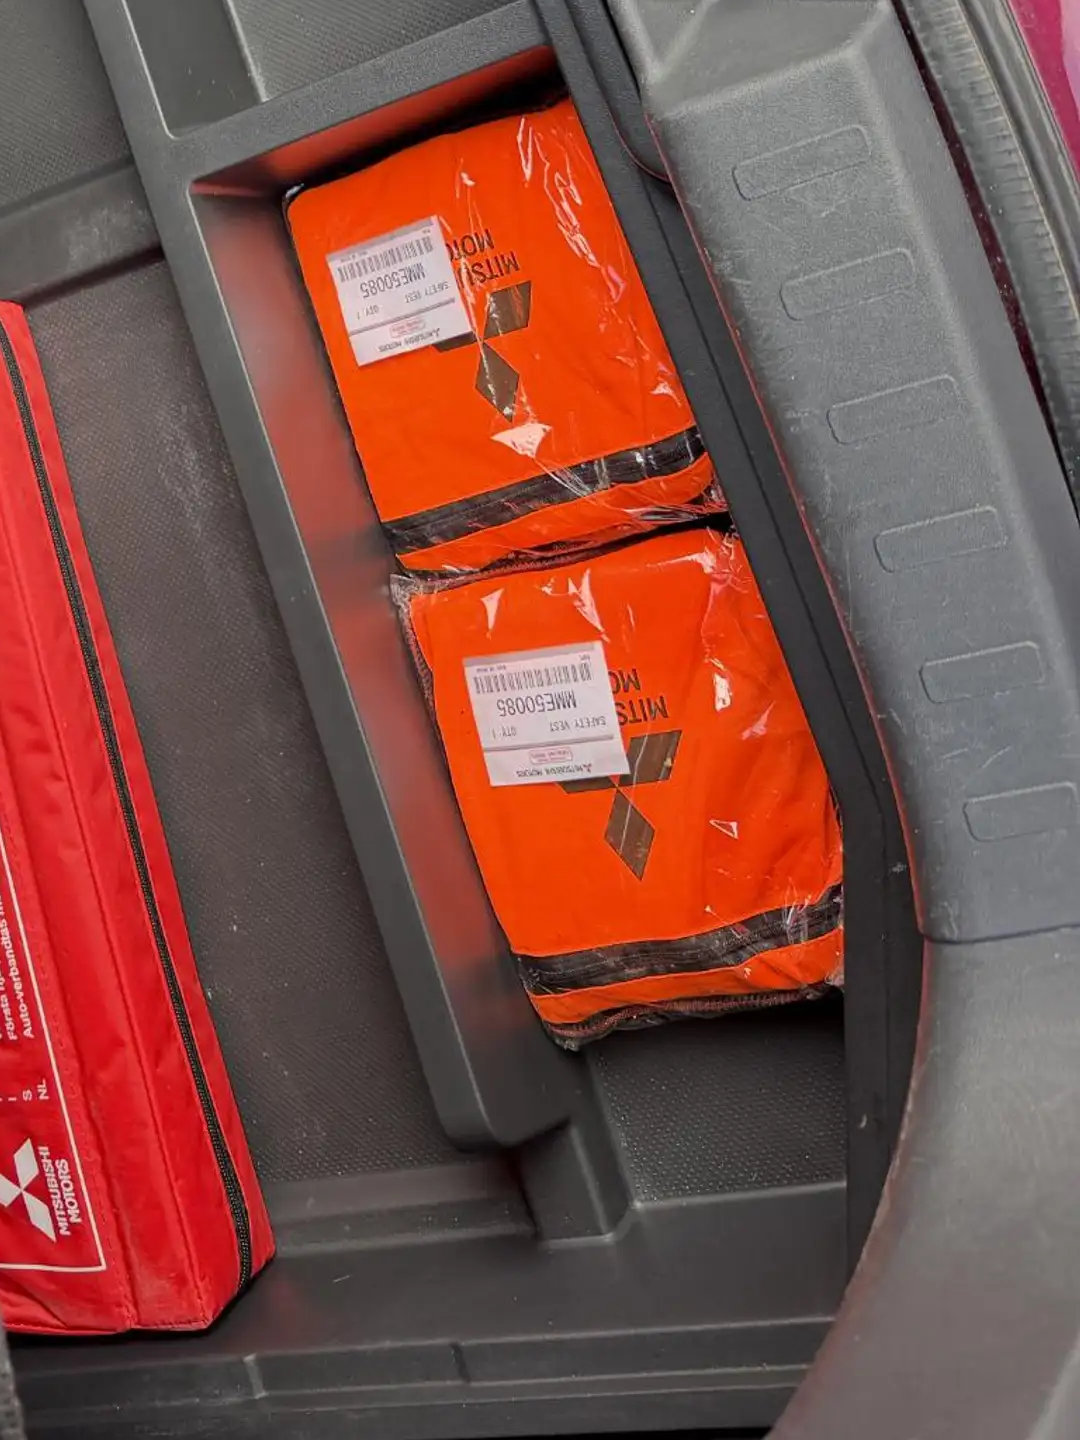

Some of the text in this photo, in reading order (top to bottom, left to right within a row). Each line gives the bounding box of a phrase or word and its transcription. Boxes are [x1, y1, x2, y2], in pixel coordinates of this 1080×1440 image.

[358, 262, 426, 298] MME50085
[423, 281, 449, 296] SAFETY
[496, 689, 576, 717] MME50085
[549, 720, 568, 731] VEST
[574, 714, 605, 728] SAFETY
[0, 919, 34, 1038] Auto-verbandtas
[0, 994, 17, 1040] Första
[23, 1090, 32, 1101] S
[37, 1078, 50, 1100] NL
[38, 1146, 70, 1235] MITSUBISHI
[55, 1159, 82, 1222] MOTORS
